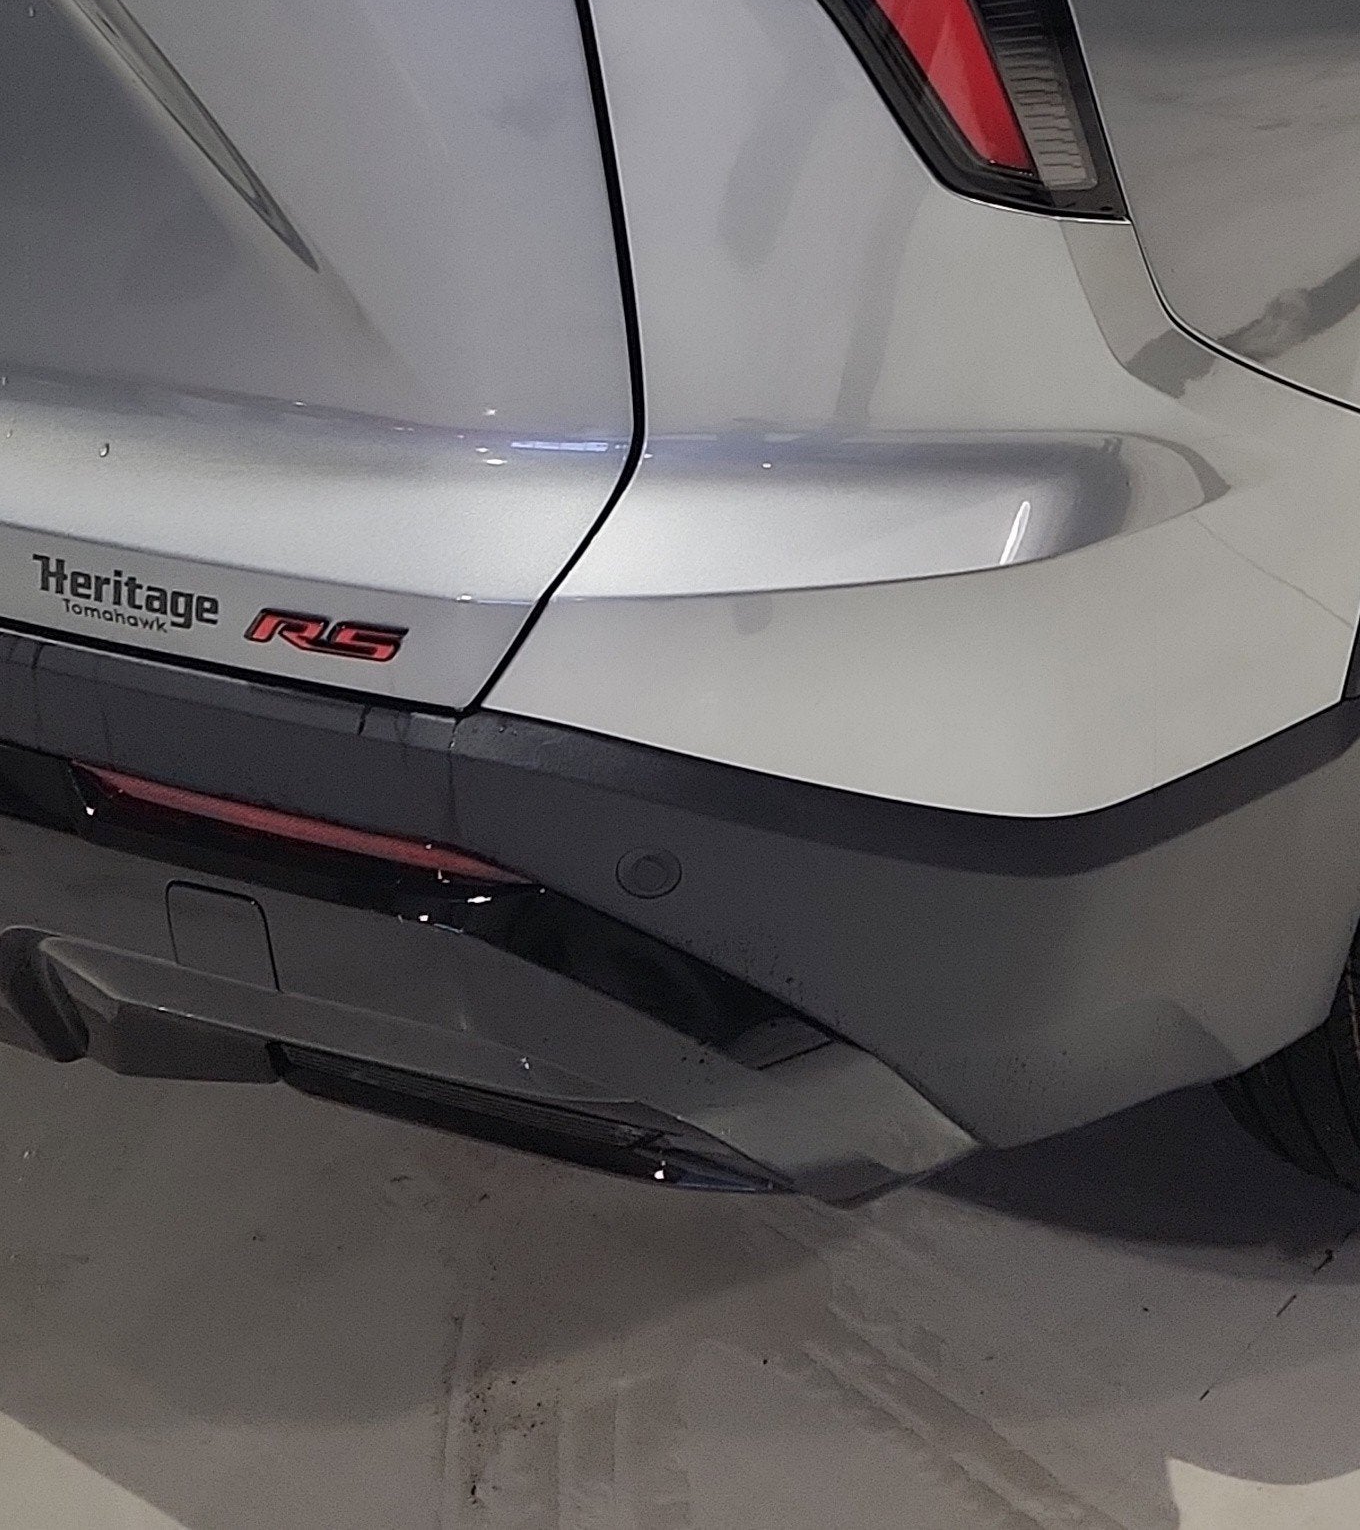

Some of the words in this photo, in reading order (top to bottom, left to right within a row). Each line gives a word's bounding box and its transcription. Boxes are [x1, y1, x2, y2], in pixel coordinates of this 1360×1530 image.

[33, 554, 219, 629] Heritage
[63, 598, 168, 633] Tomahawk
[243, 608, 409, 663] RS
